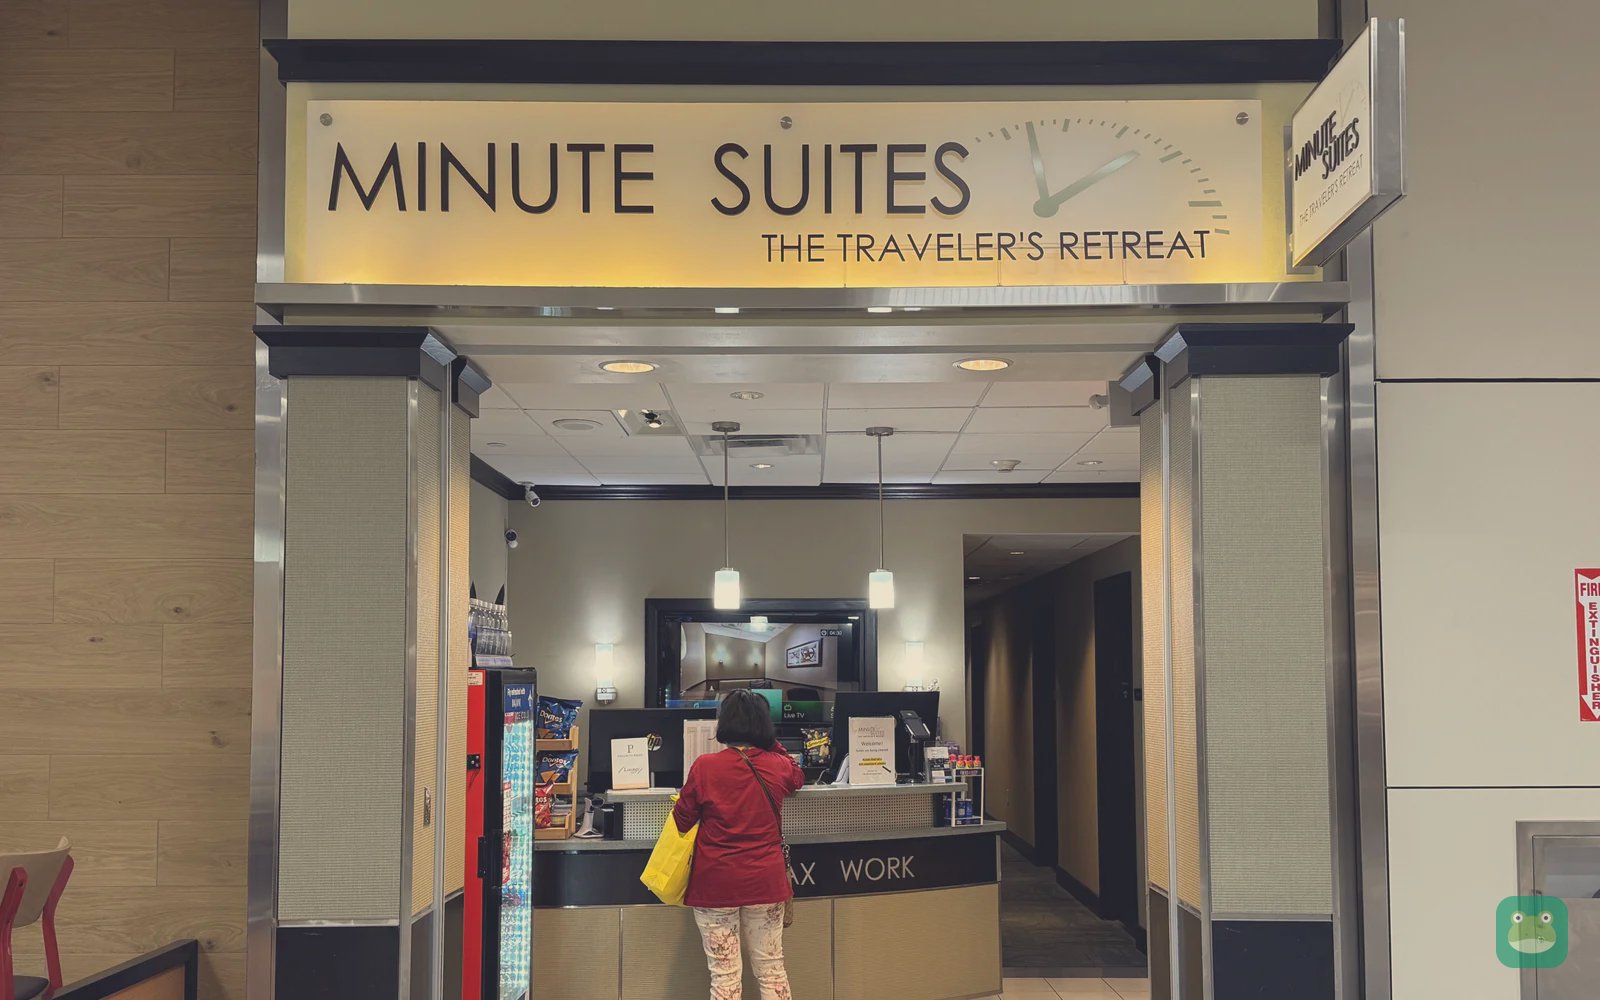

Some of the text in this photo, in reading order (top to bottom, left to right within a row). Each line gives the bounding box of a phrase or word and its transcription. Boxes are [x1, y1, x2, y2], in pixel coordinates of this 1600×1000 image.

[1295, 110, 1337, 181] MINUTE
[1322, 117, 1360, 180] SUITES
[328, 141, 971, 217] MINUTE SUITES
[1339, 153, 1364, 187] RETREAT
[762, 229, 1211, 263] THE TRAVELER'S RETREAT
[1580, 582, 1600, 597] FIR
[540, 709, 564, 724] Doritos
[542, 756, 567, 766] Doritos
[840, 856, 915, 882] WORK
